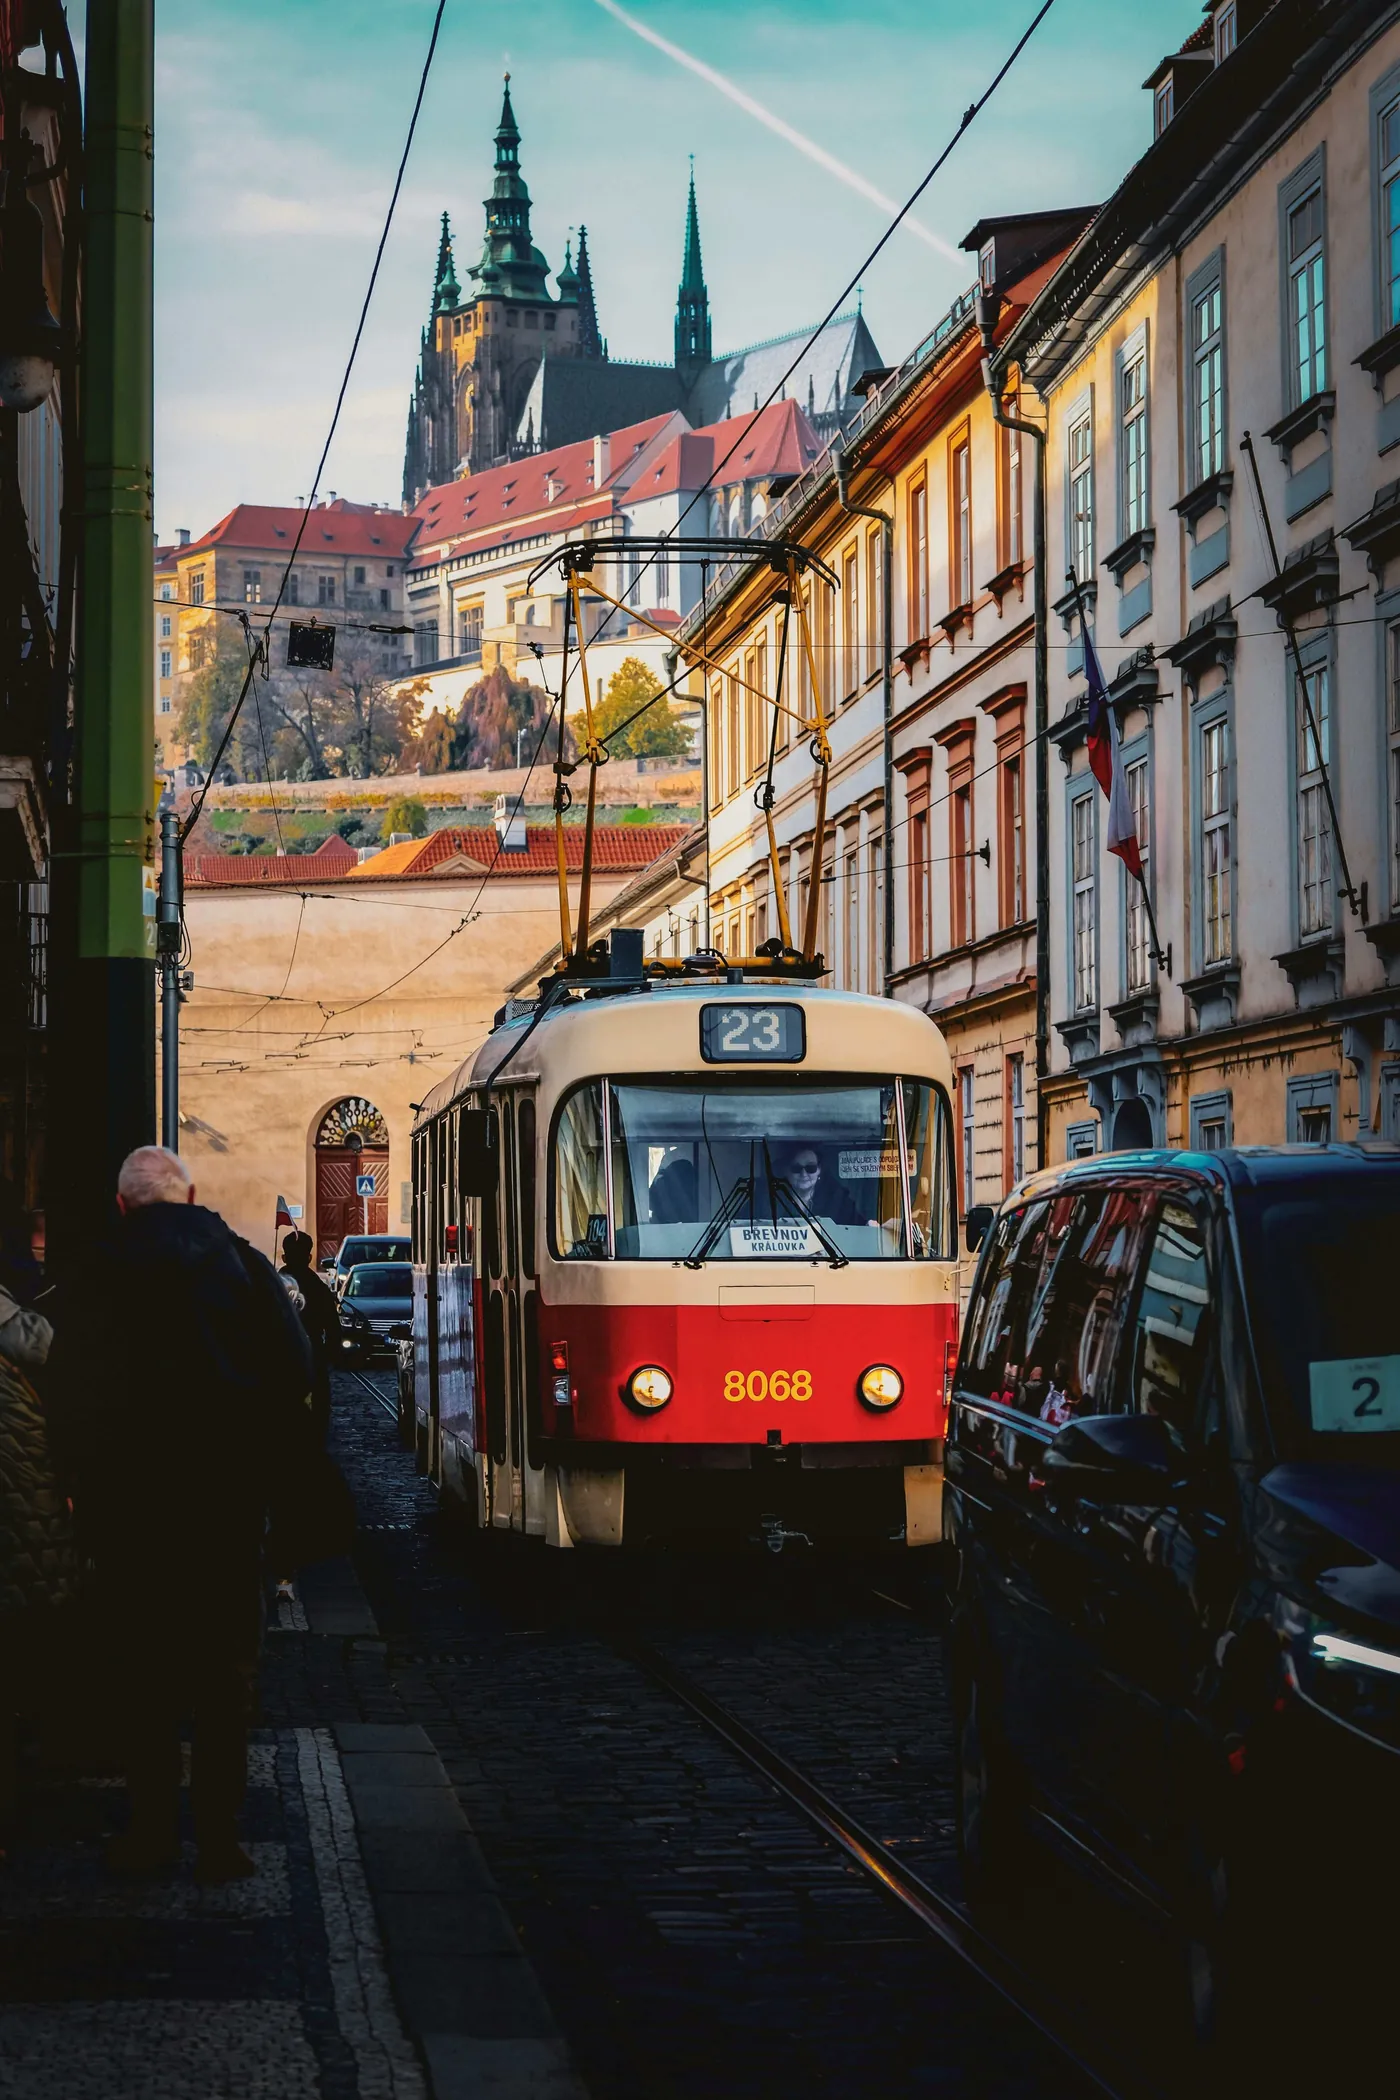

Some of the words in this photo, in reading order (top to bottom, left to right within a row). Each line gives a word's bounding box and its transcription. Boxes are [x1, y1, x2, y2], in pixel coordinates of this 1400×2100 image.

[722, 1009, 780, 1051] 23
[588, 1218, 607, 1242] 104
[743, 1226, 808, 1241] BŘEVNOV
[752, 1240, 806, 1252] KRÁLOVKA
[723, 1369, 813, 1402] 8068
[1352, 1376, 1383, 1417] 2
